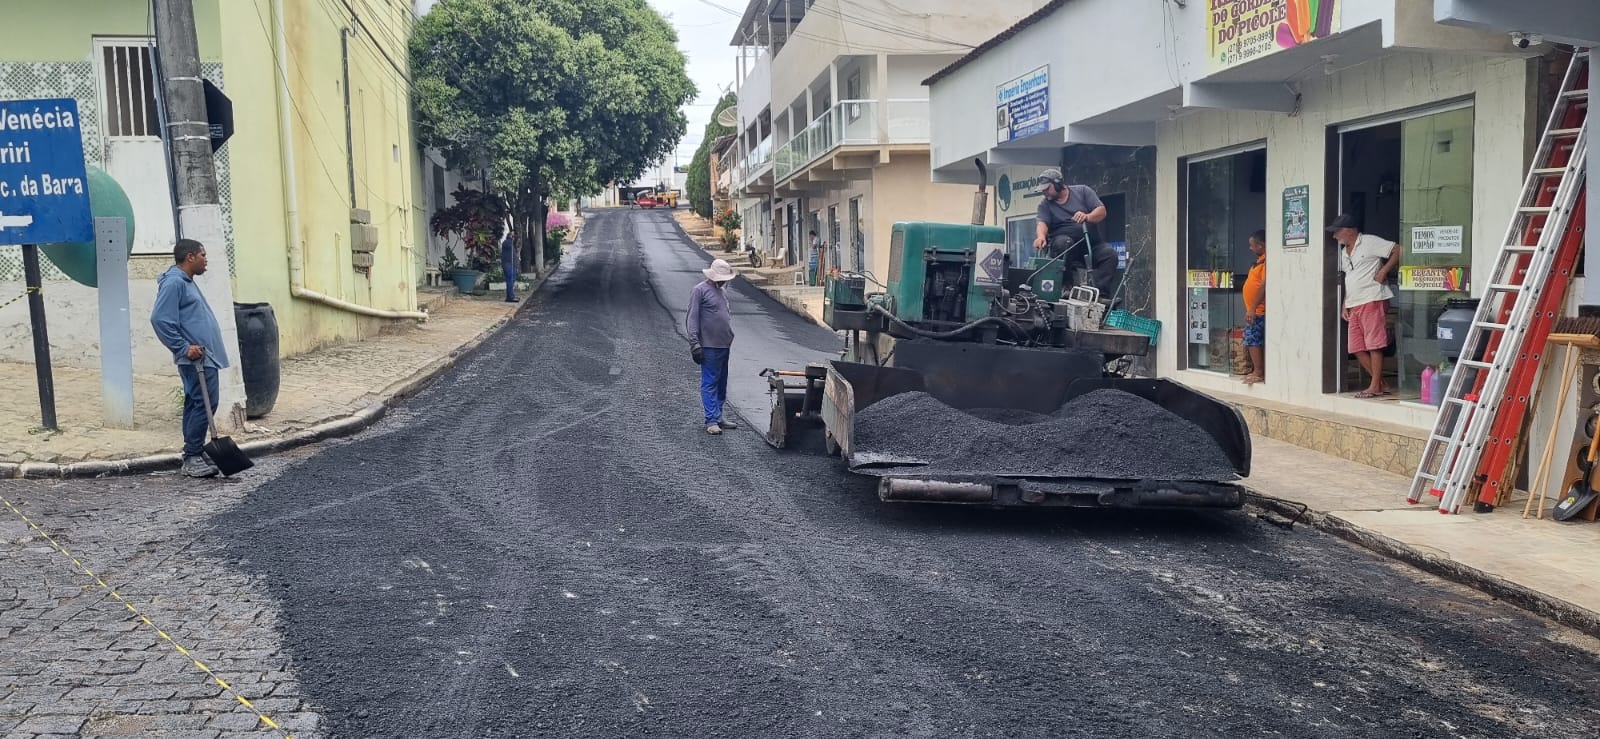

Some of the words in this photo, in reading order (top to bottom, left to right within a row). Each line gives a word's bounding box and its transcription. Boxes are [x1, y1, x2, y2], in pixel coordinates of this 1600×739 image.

[1213, 8, 1228, 27] DO
[1218, 25, 1234, 45] DO
[1020, 71, 1047, 95] Engenharia
[20, 174, 39, 197] da
[1414, 231, 1435, 240] TEMOS
